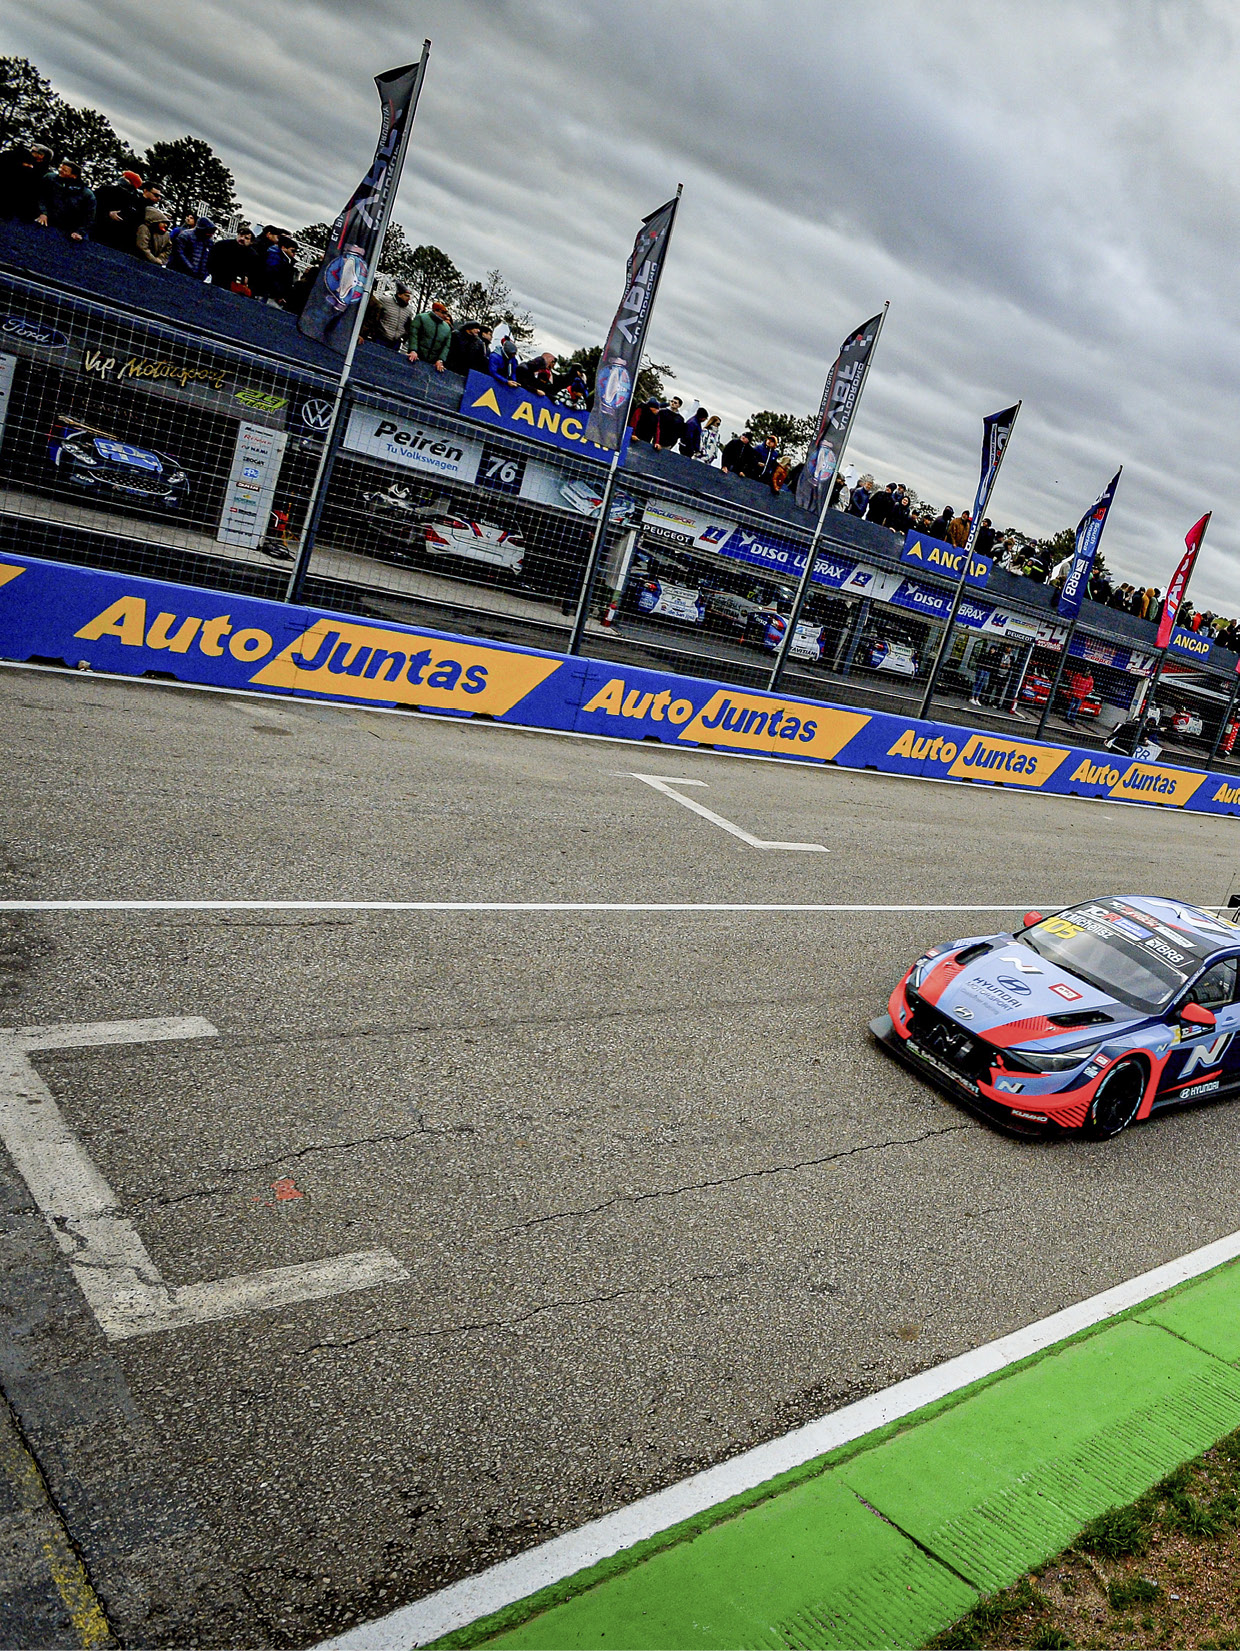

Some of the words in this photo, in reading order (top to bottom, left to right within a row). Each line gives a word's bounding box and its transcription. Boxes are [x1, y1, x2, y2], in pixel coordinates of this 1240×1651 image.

[2, 318, 50, 343] Ford
[511, 401, 609, 452] ANC
[374, 419, 464, 462] Peirén
[386, 442, 398, 454] Tu
[400, 447, 458, 472] Volkswagen
[484, 456, 519, 483] 76
[643, 524, 691, 543] PEUGEOT
[927, 547, 987, 578] ANCP
[1065, 571, 1080, 597] BRB
[73, 595, 273, 663] Auto
[1007, 630, 1034, 643] PEUGEOT
[1173, 634, 1210, 655] ANCAP
[582, 678, 696, 725] Auto
[888, 729, 958, 764] Auto
[1085, 905, 1122, 923] TCR
[1037, 916, 1085, 939] 105
[1156, 939, 1186, 964] BRB
[965, 981, 1015, 1012] MOTORSPORT
[972, 977, 1023, 1008] HYUNDAI
[1191, 1081, 1220, 1095] HYUNDAI
[1011, 1109, 1049, 1123] KUMHO
